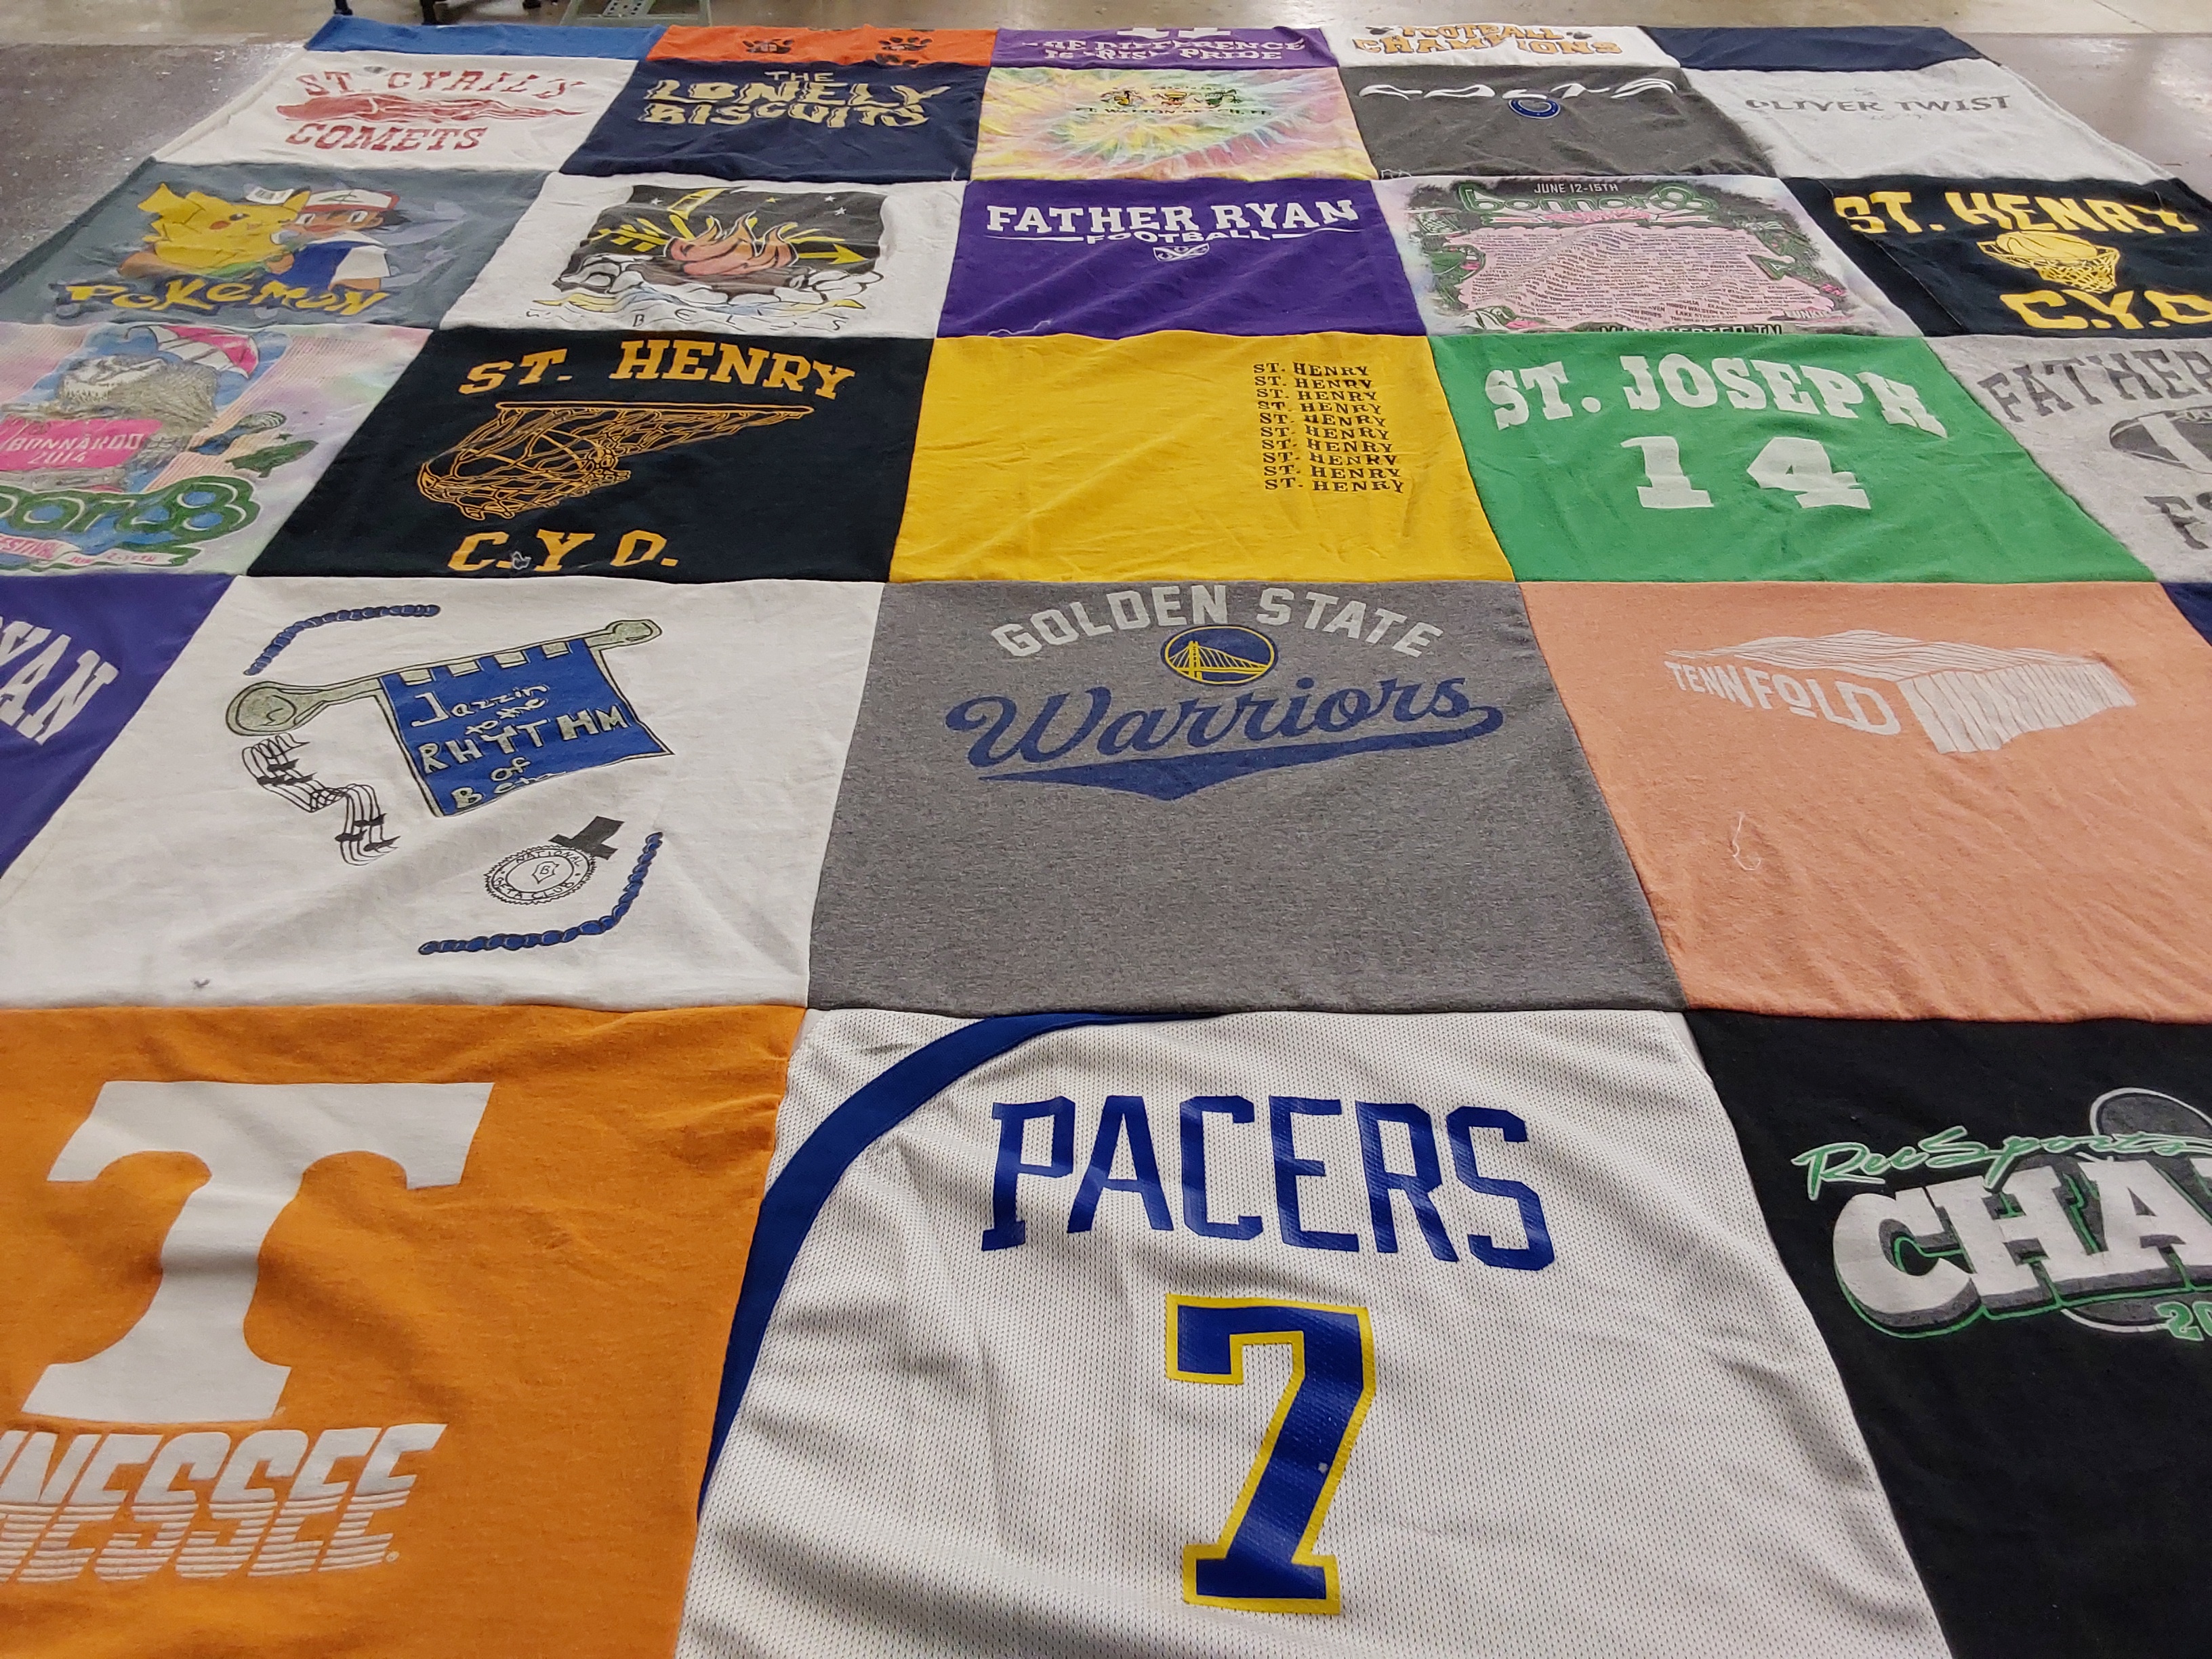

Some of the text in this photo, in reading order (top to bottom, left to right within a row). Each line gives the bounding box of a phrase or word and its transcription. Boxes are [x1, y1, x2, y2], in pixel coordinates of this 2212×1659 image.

[1400, 24, 1563, 40] FOOTBALL
[1353, 35, 1622, 54] CHAMPIONS
[1180, 49, 1282, 60] PRIDE
[764, 71, 834, 82] THE
[644, 79, 951, 106] LONELY
[1744, 95, 2011, 112] OLIVER TWIST
[638, 103, 930, 127] BISCUITS
[286, 123, 488, 152] COMETS
[1534, 183, 1619, 194] JUNE 12-15TH
[986, 199, 1359, 233] FATHER RYAN
[1833, 191, 2200, 234] ST. HENRY
[1087, 229, 1271, 245] FOOTBALL
[458, 339, 855, 401] ST. HENRY
[1254, 361, 1370, 376] ST. HENRY
[1254, 376, 1372, 389] ST. HENRY
[1256, 389, 1377, 401] ST. HENRY
[1485, 353, 1948, 438] ST. JOSEPH
[1258, 401, 1381, 415] ST. HENRY
[1260, 413, 1387, 428] ST. HENRY
[1261, 424, 1390, 440] ST. HENRY
[1262, 438, 1393, 453] ST. HENRY
[28, 451, 88, 465] 2014
[1263, 451, 1398, 466] ST. HENRY
[1264, 465, 1401, 480] ST. HENRY
[1265, 478, 1404, 493] ST. HENRY
[990, 584, 1443, 659] GOLDEN STATE
[0, 616, 119, 745] YAN
[411, 684, 550, 727] Jazzin
[945, 678, 1501, 779] Warriors
[490, 756, 532, 781] of
[516, 849, 581, 867] NATIONAL
[493, 877, 575, 900] BETA CLUB
[981, 1095, 1555, 1272] PACERS
[1832, 1156, 2212, 1322] CHA
[21, 1081, 495, 1424] T
[1166, 1293, 1376, 1615] 7
